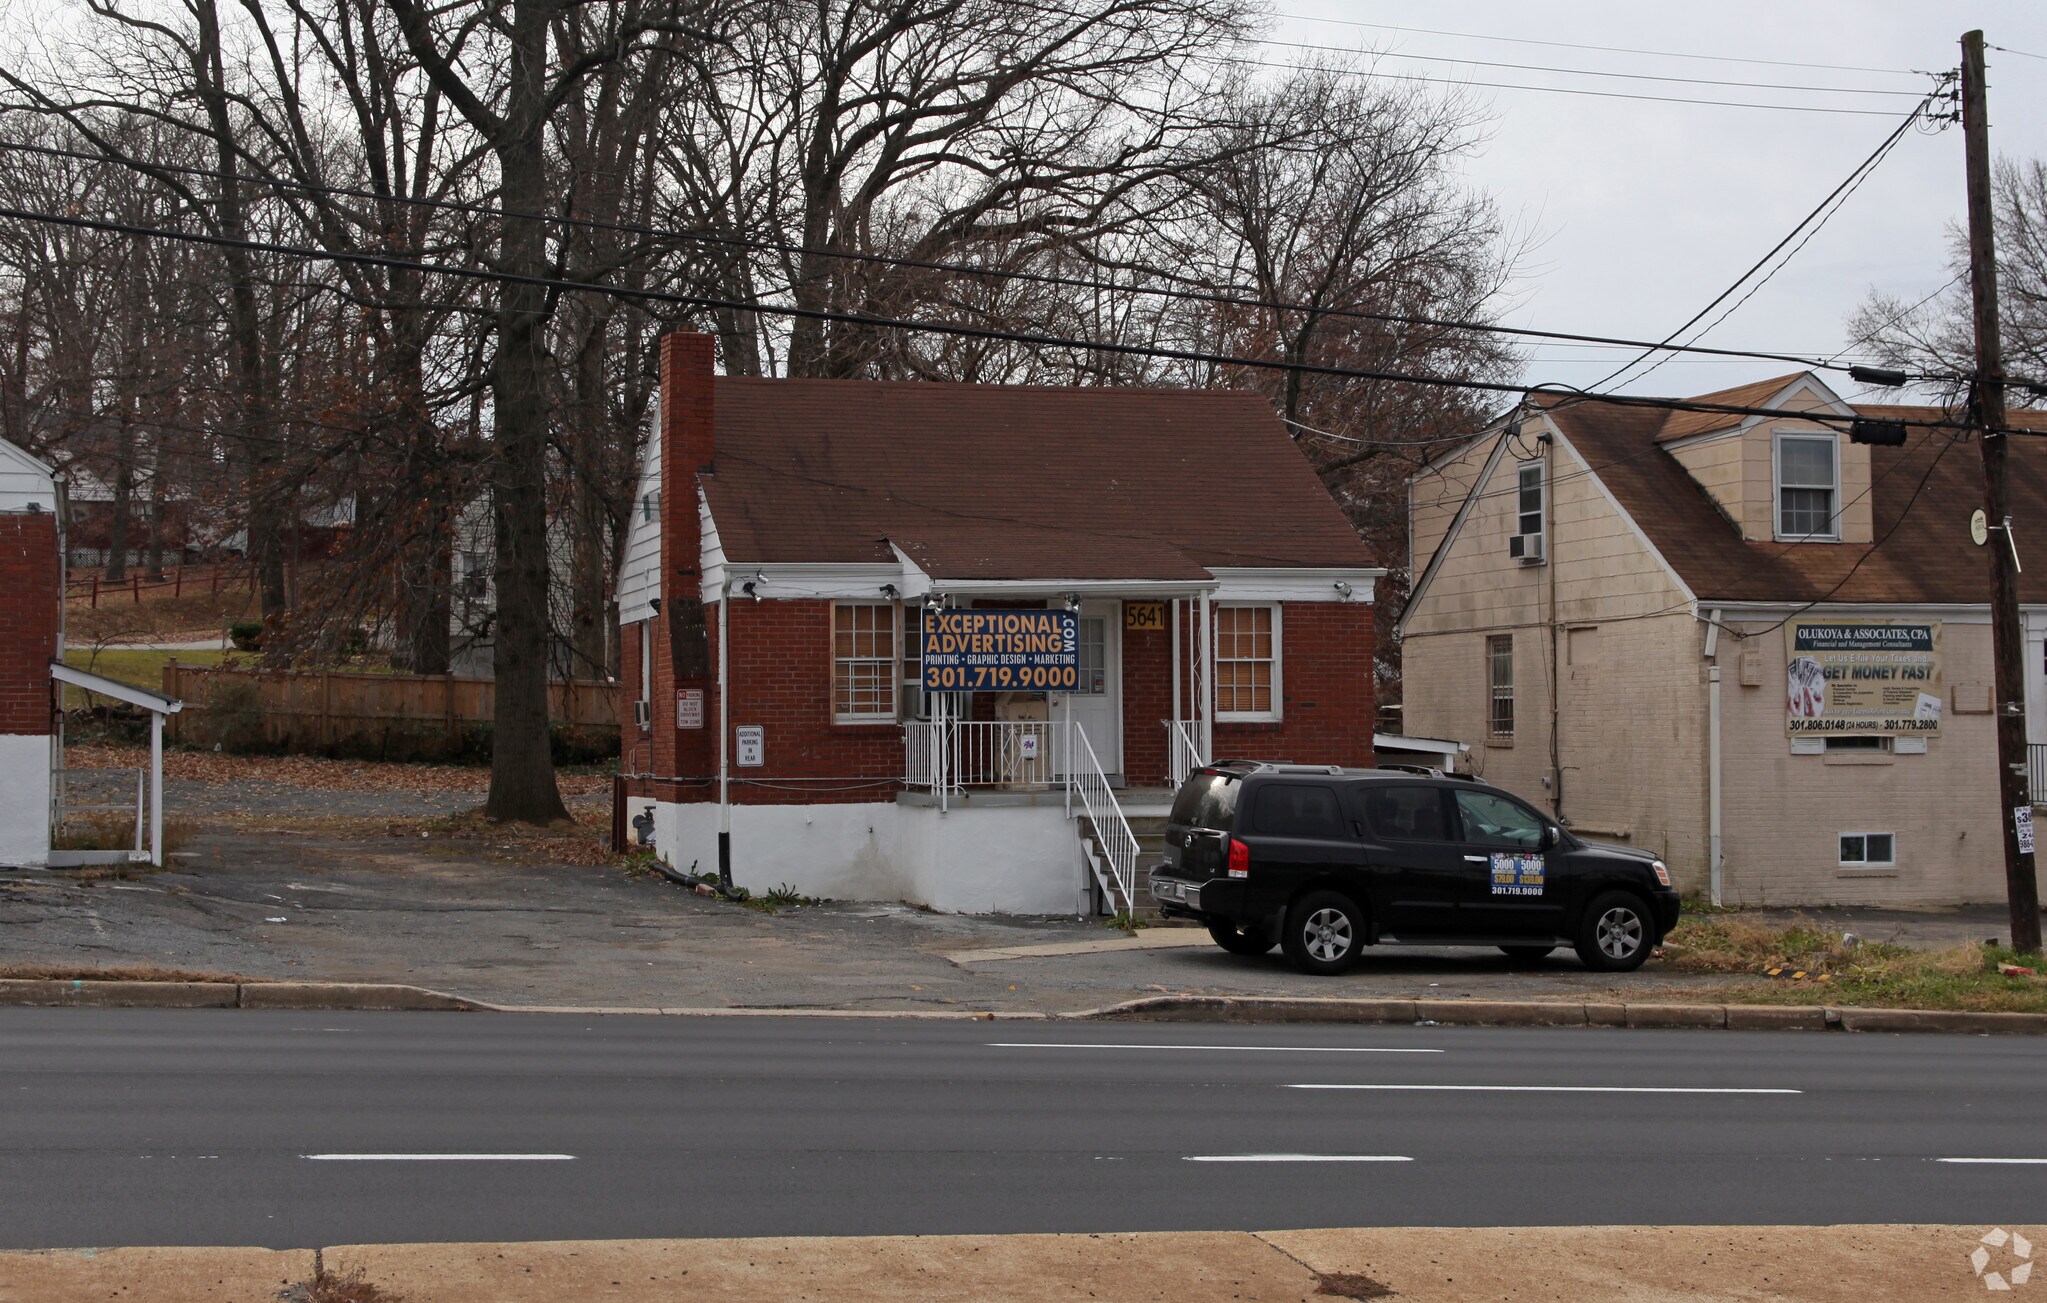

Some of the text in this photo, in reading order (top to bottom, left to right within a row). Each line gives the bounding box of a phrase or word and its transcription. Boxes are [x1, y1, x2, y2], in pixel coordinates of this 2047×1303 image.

[1127, 605, 1164, 627] 5641
[925, 614, 1062, 634] EXCEPTIONAL
[1062, 614, 1075, 653] .COM
[1799, 628, 1929, 641] OLUKOYA & ASSOCIATES, CPA
[926, 634, 1063, 654] ADVERTISING
[1812, 640, 1837, 648] Financial
[1849, 640, 1881, 649] Management
[1882, 640, 1912, 648] Consultants
[925, 654, 1075, 665] PRINTING GRAPHIC DESIGN MARKETING
[1824, 654, 1837, 663] Let
[1838, 654, 1848, 663] Us
[1871, 654, 1888, 663] Your
[1890, 654, 1911, 663] Taxes
[926, 666, 1076, 688] 301.719.9000
[1823, 665, 1935, 680] GET MONEY FAST
[1789, 719, 1846, 731] 301.806.0148
[1855, 721, 1879, 730] HOURS)
[1884, 719, 1938, 730] 301.779.2800
[1495, 859, 1514, 869] 5000
[1521, 860, 1541, 871] 5000
[1492, 887, 1543, 895] 301.719.9000
